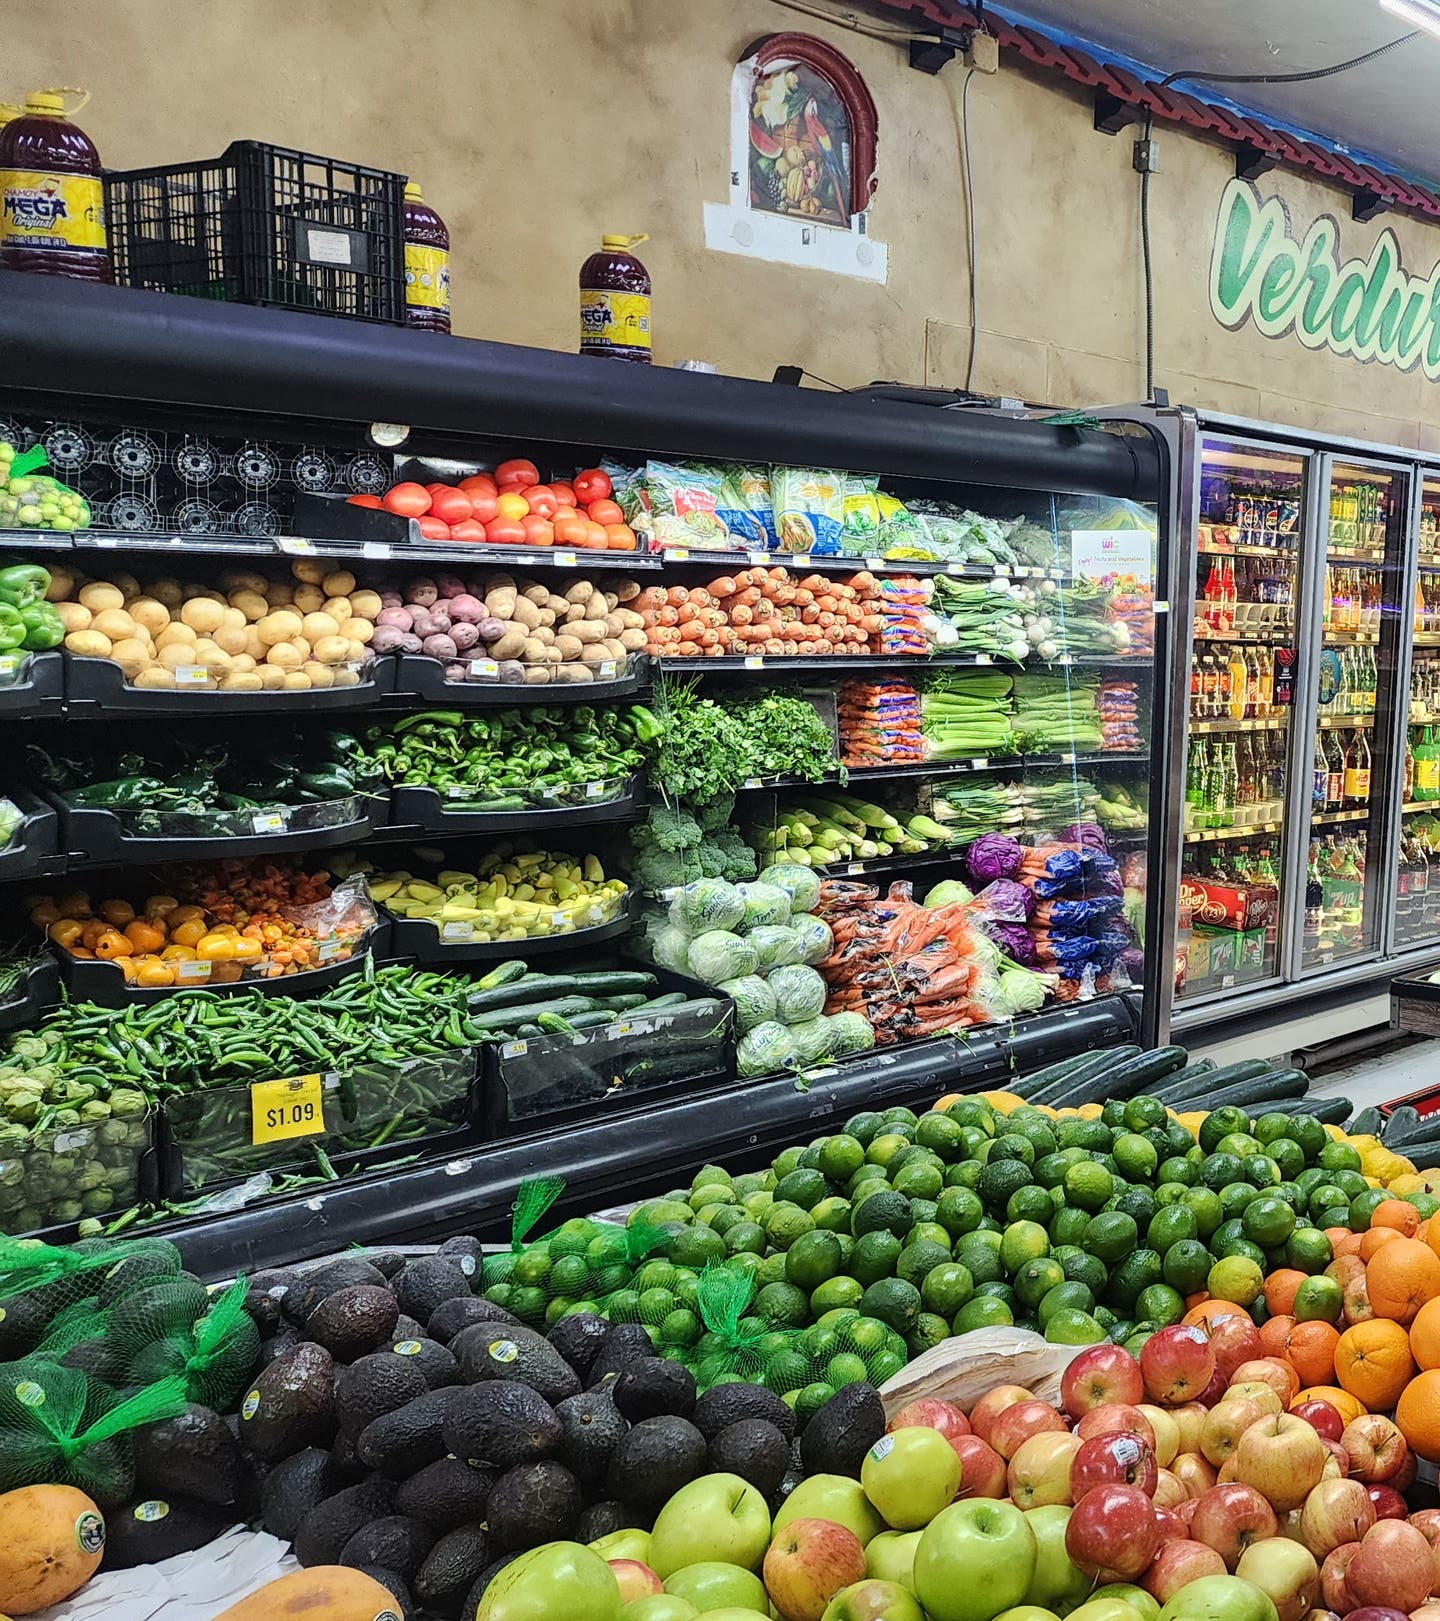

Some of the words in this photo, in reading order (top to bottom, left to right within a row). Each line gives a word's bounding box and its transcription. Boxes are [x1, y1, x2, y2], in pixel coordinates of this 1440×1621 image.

[4, 197, 67, 217] MEGA
[13, 214, 56, 230] Original
[581, 309, 612, 323] EGA
[267, 1102, 314, 1128] $1.09
